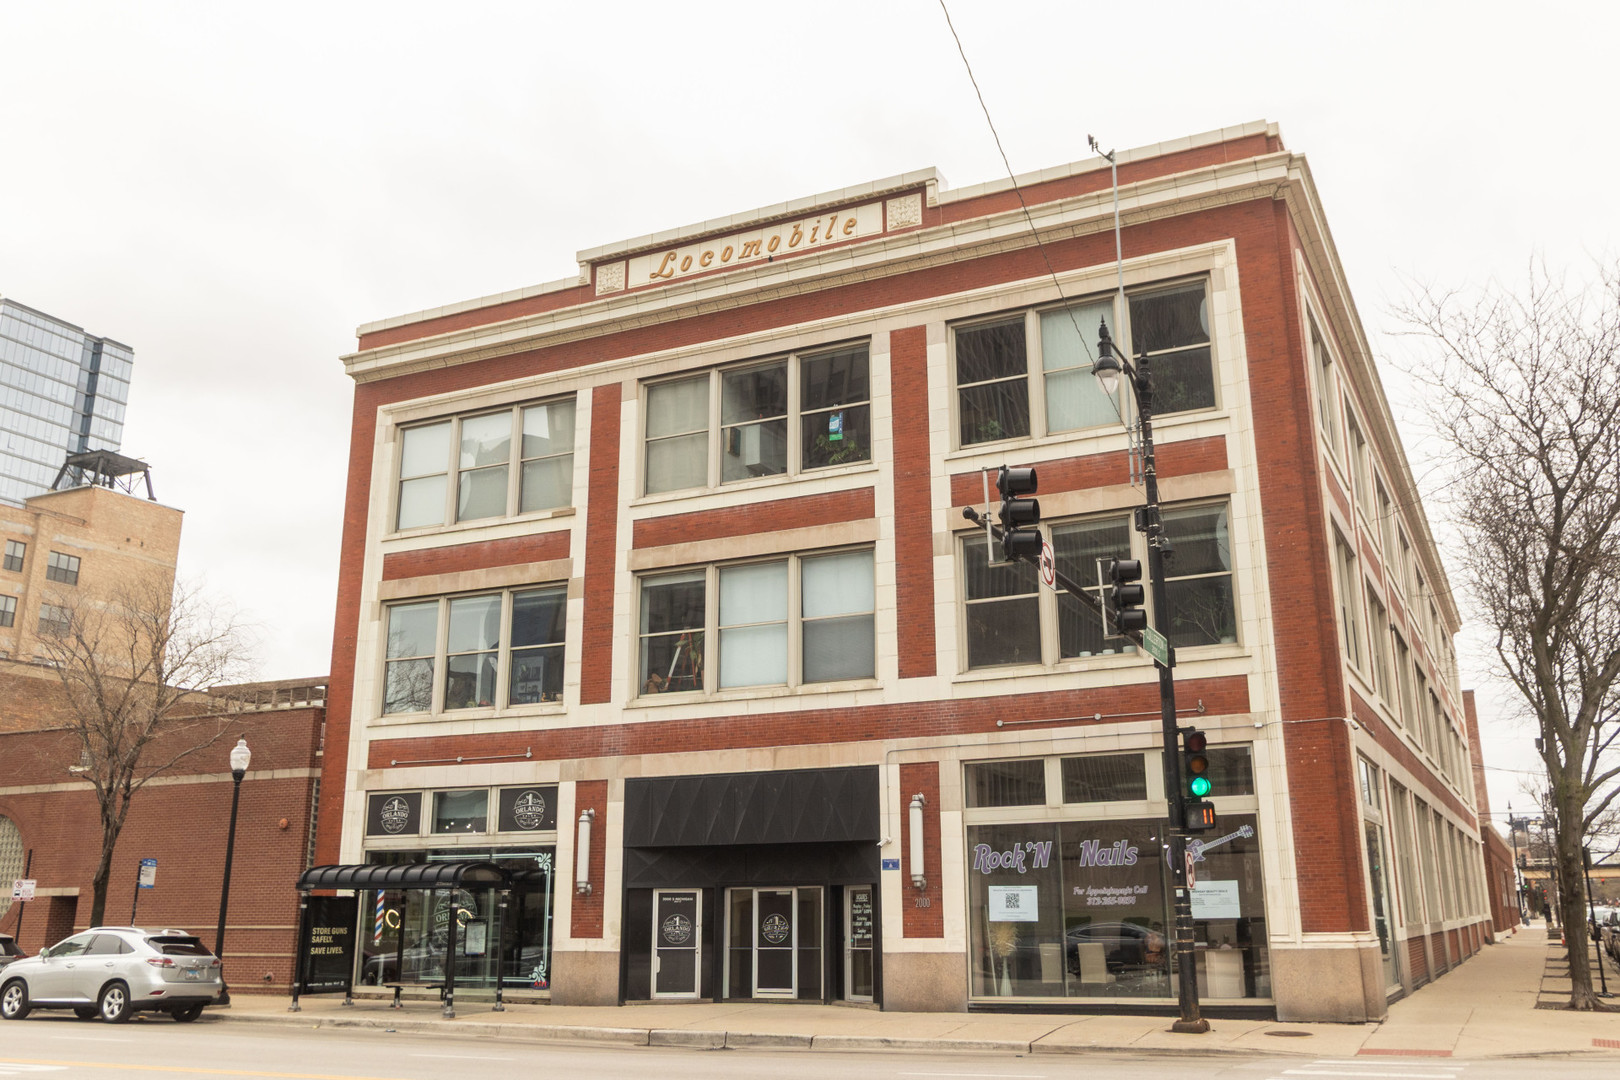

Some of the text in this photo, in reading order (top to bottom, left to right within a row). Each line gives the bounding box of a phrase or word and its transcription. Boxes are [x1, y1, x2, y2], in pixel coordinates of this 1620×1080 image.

[649, 215, 858, 279] Locomobile
[515, 806, 544, 814] ORLANDO
[382, 811, 409, 819] ORLANDO
[1203, 808, 1214, 824] 11
[1080, 840, 1139, 867] Nails
[914, 897, 931, 908] 2000
[312, 927, 348, 935] STORE GUNS
[311, 935, 333, 943] SAFELY.
[310, 946, 344, 955] SAVE LIVES.
